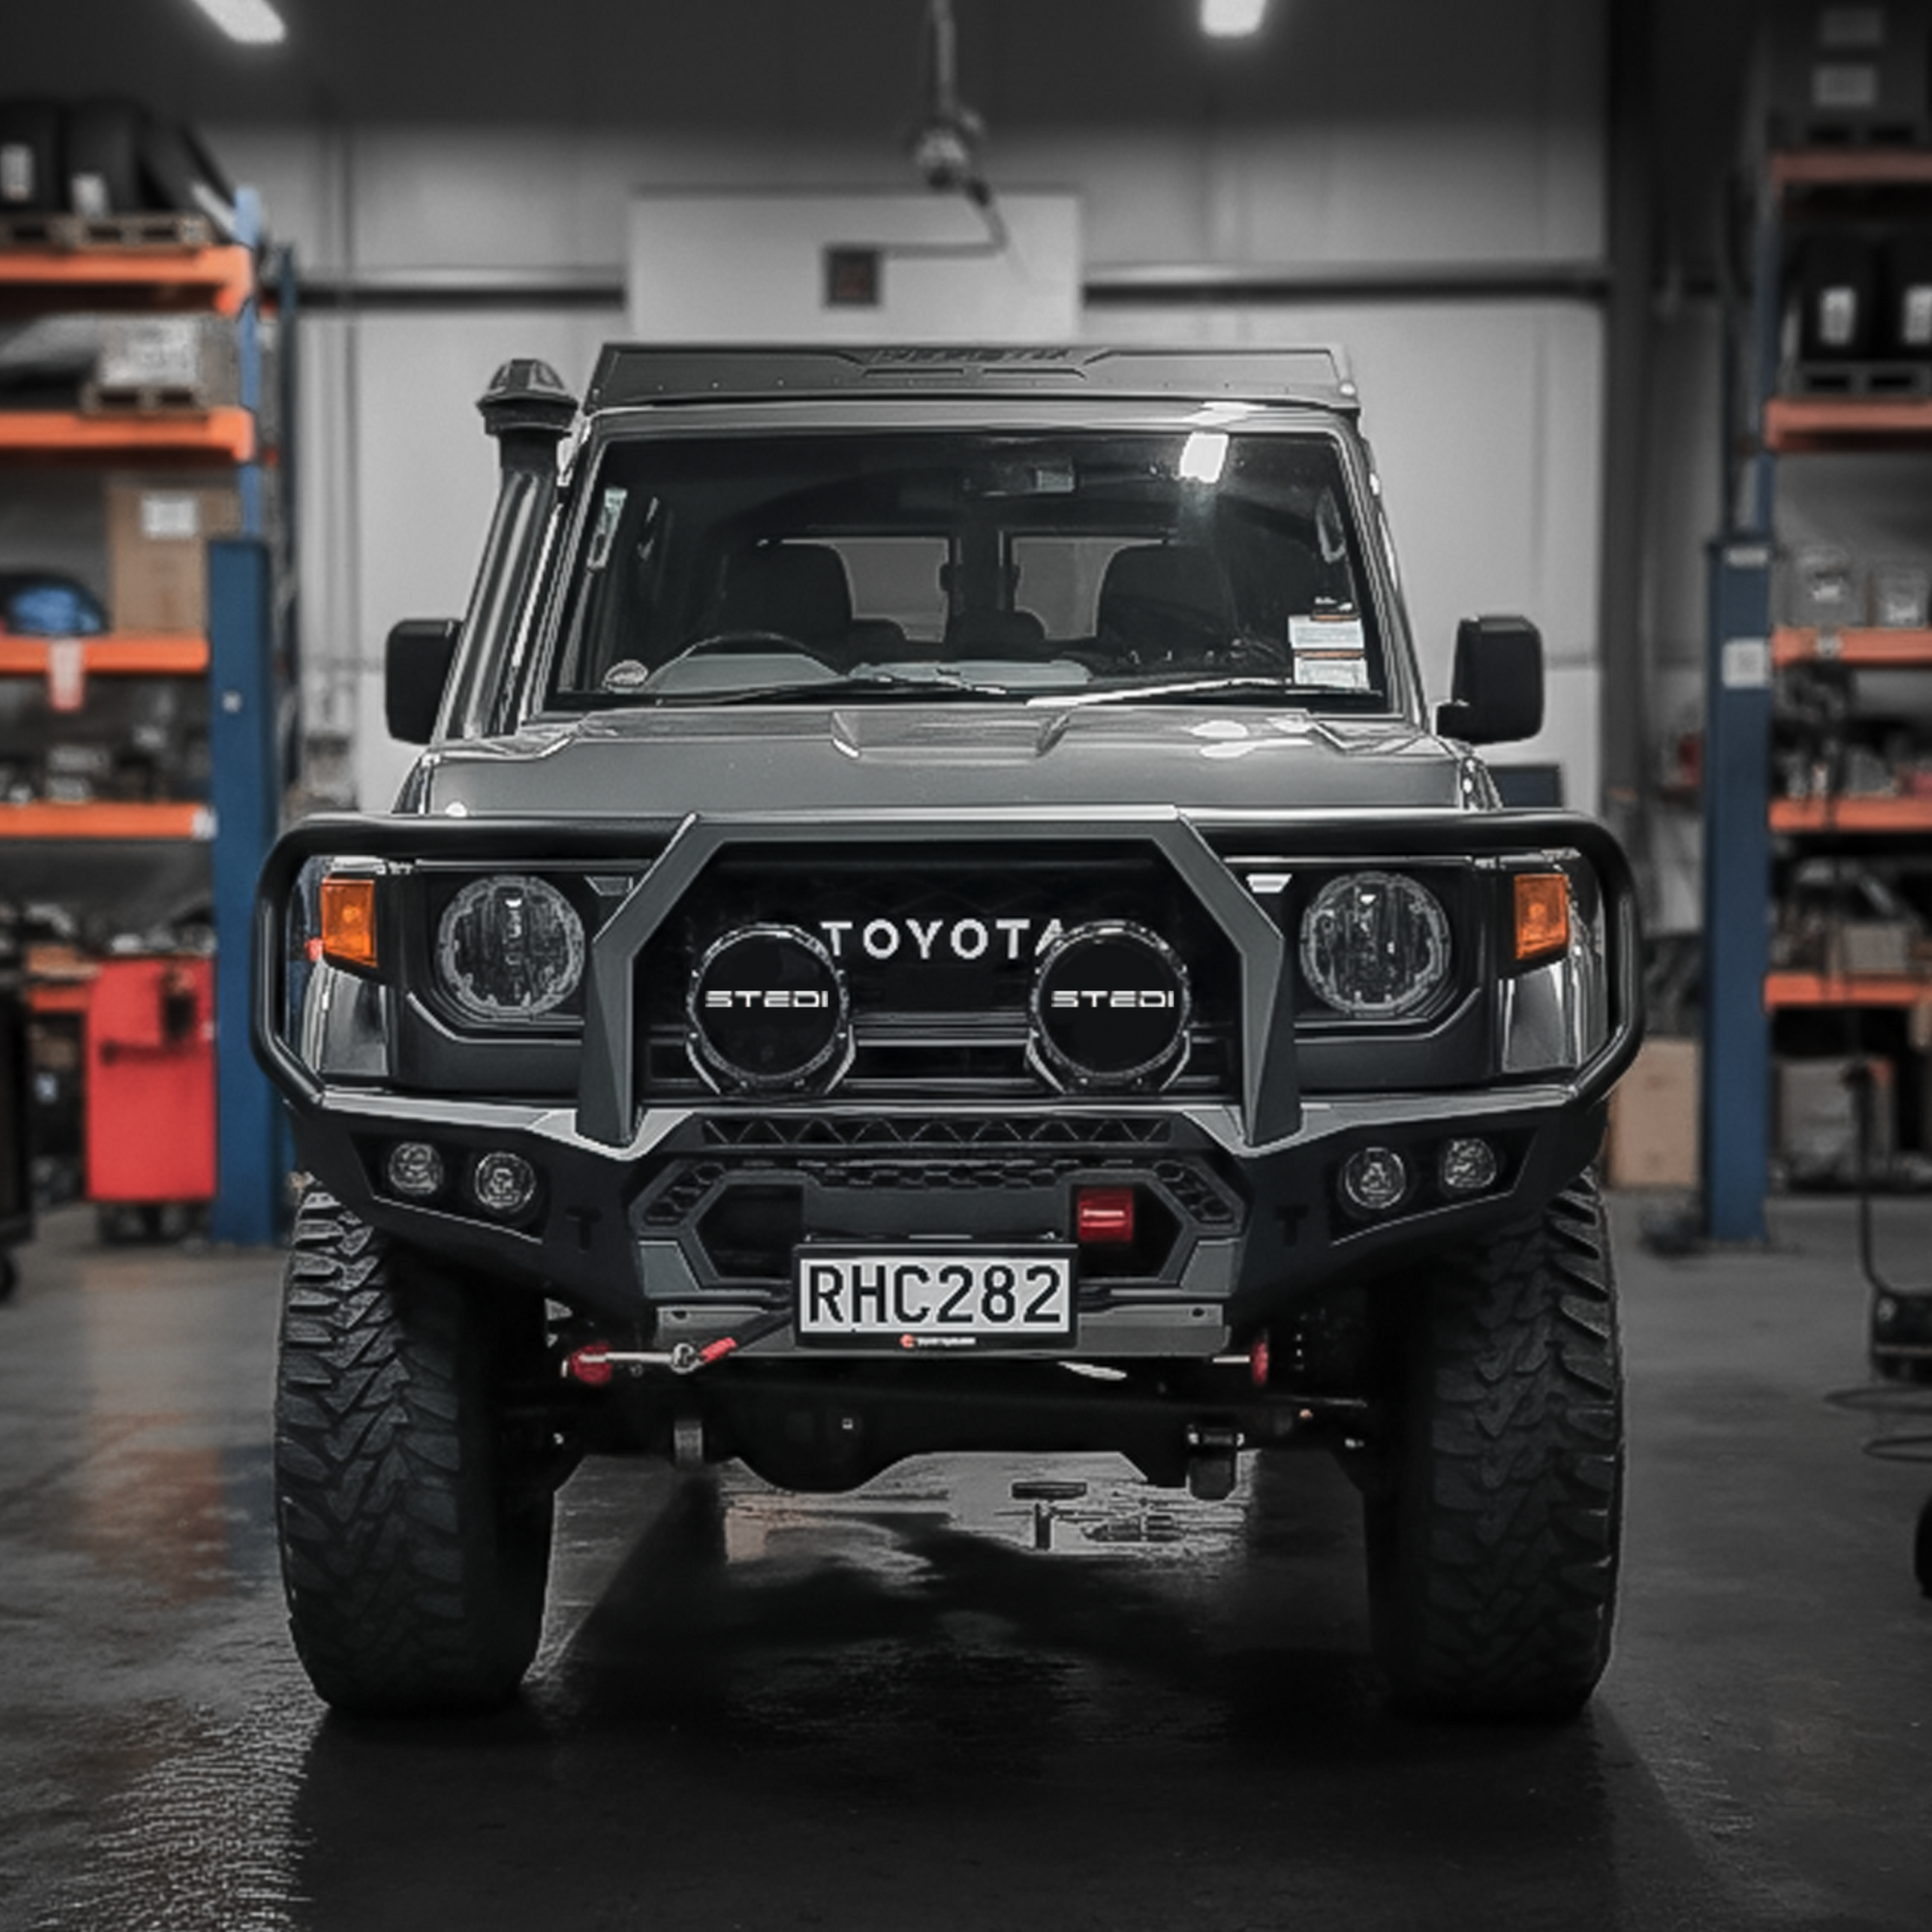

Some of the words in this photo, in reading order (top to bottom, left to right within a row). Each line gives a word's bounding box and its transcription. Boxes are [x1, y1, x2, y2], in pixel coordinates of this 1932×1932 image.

[704, 989, 830, 1008] STEDI
[1050, 989, 1176, 1008] STEDI
[809, 1264, 1061, 1323] RHC282
